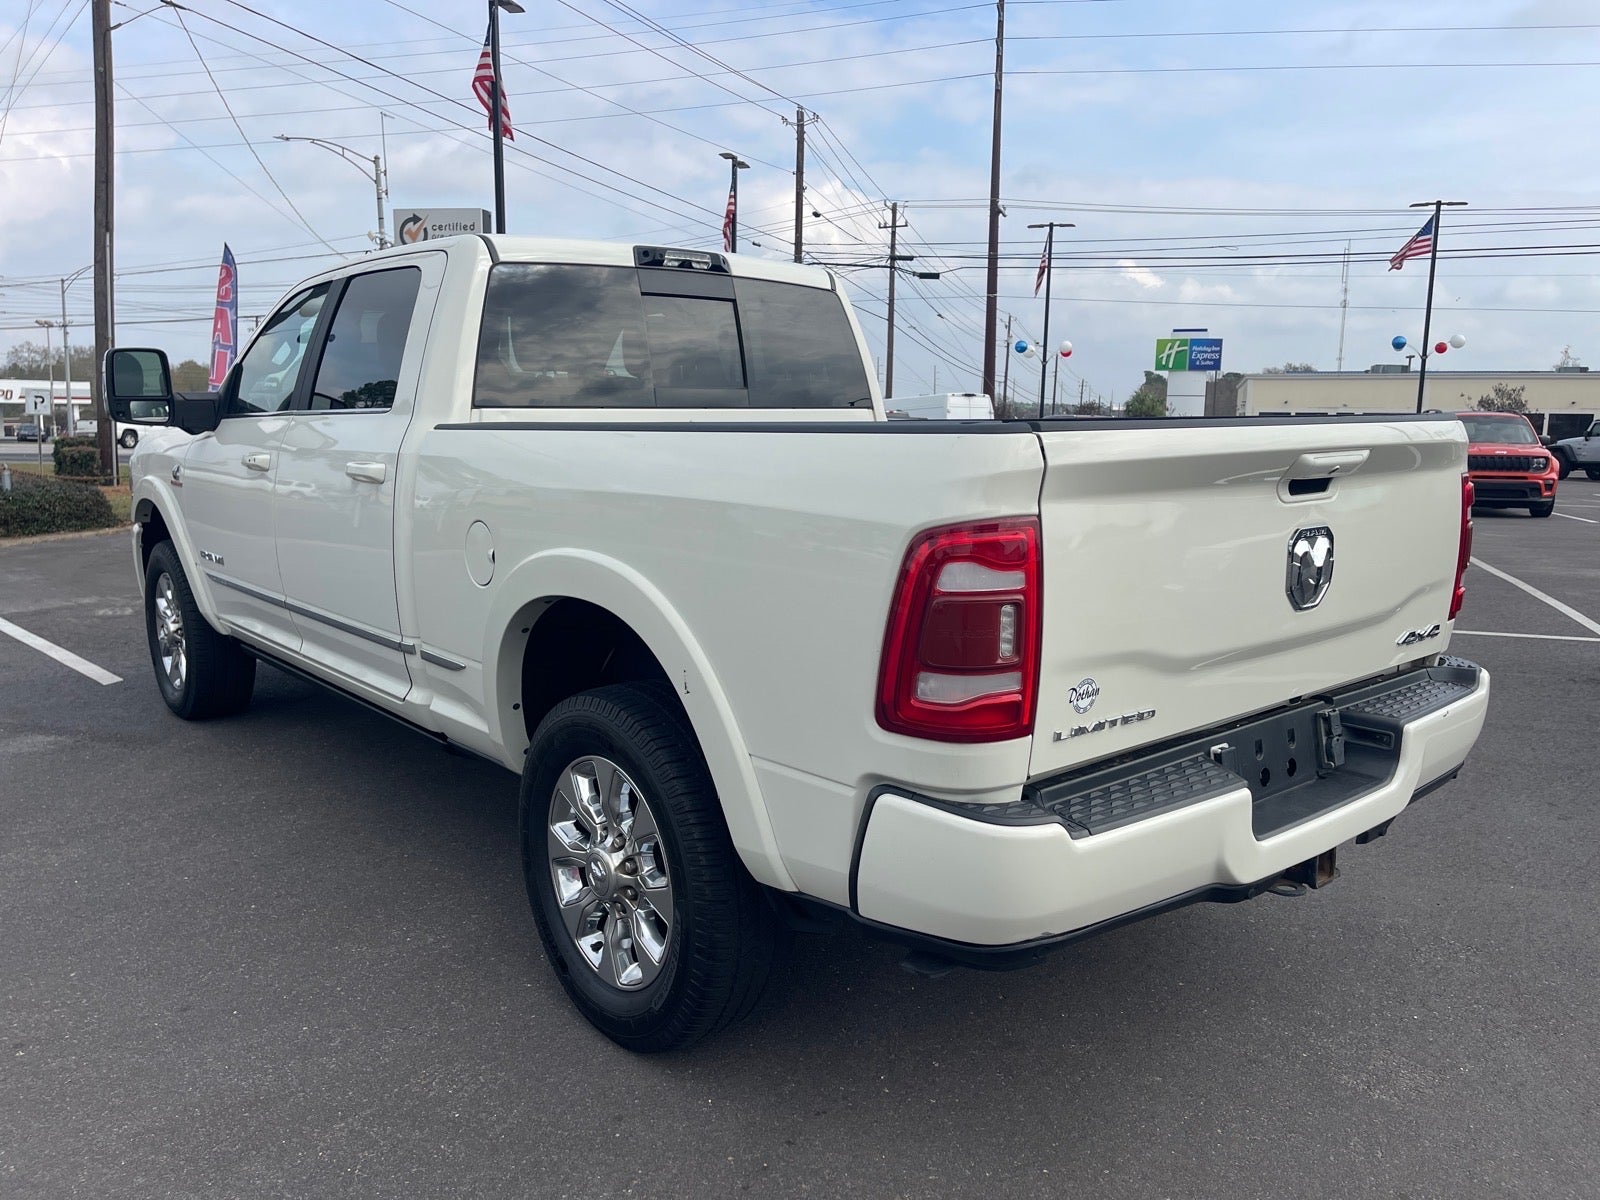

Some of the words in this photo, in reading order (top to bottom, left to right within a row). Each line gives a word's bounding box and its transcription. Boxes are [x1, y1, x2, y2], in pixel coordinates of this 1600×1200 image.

[431, 221, 476, 231] certified
[1191, 351, 1220, 360] Express
[1067, 685, 1100, 703] Dothan
[1052, 709, 1157, 742] LIMITED
